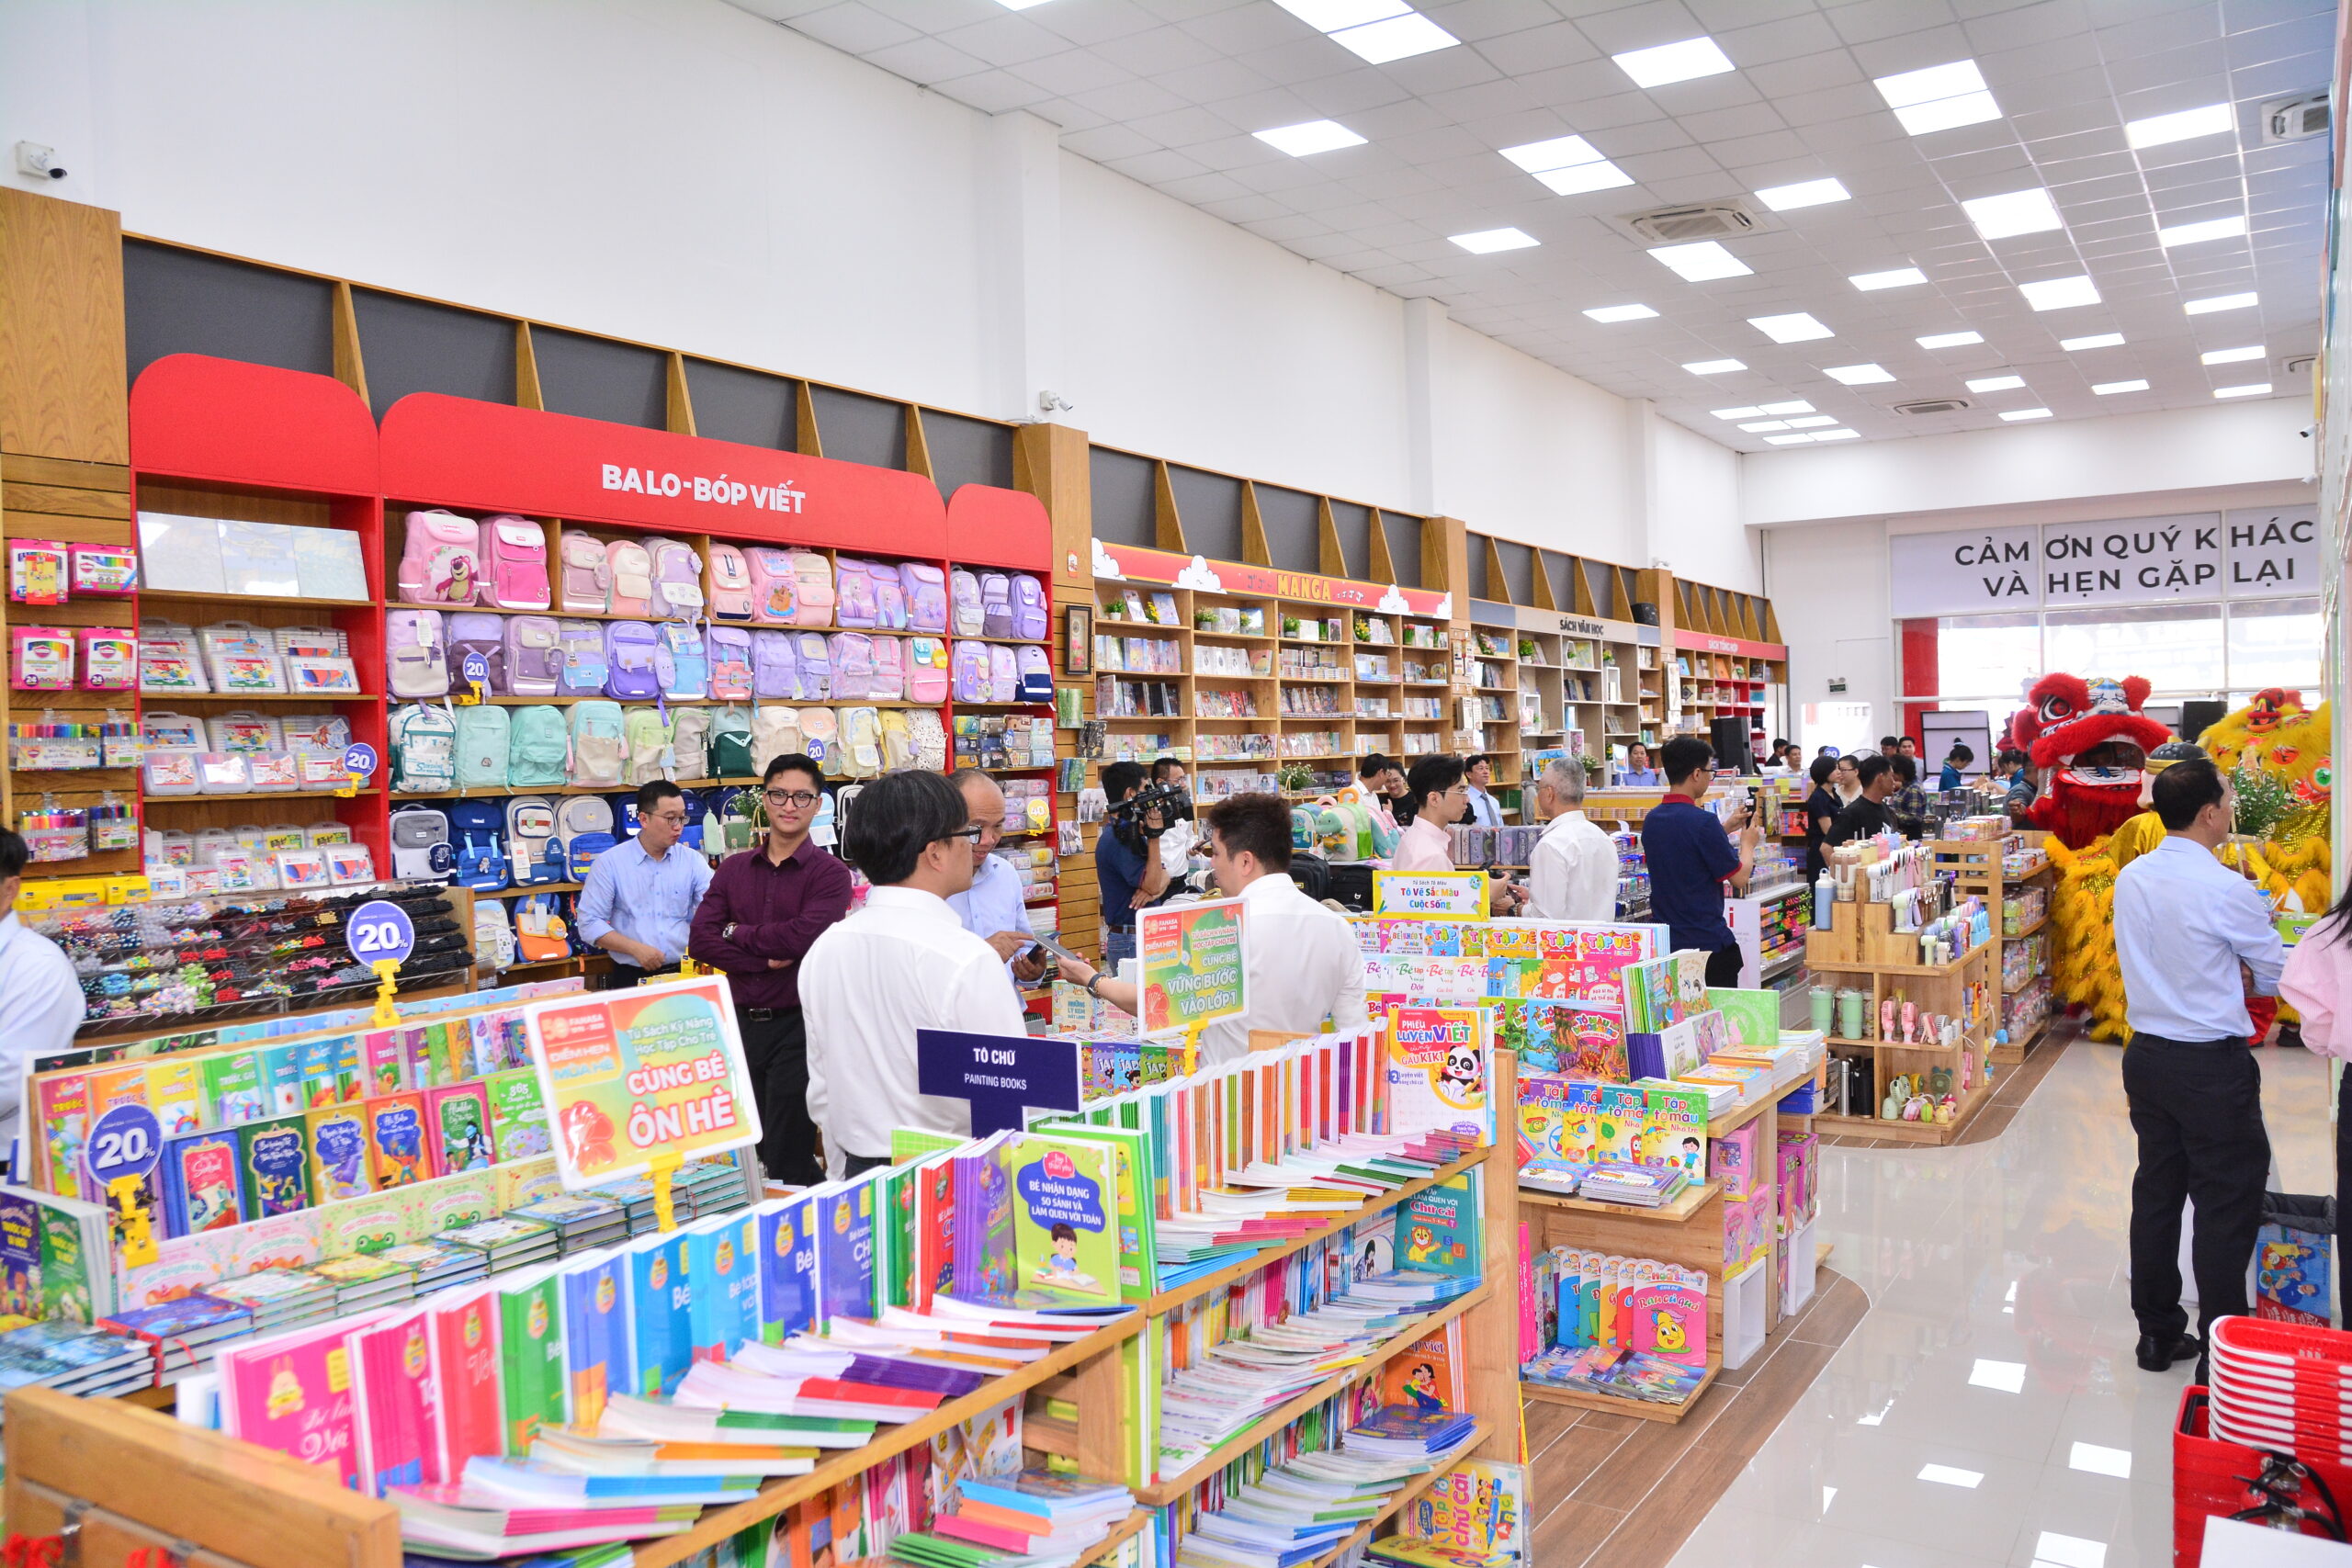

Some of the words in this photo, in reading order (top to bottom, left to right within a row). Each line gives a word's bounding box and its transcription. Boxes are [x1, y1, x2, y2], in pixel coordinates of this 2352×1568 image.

[602, 463, 748, 506] BALO-BÓP
[750, 479, 806, 514] VIẾT
[1954, 536, 2030, 567] CẢM
[2044, 534, 2093, 560] ƠN
[2102, 525, 2182, 560] QUÝ
[1983, 570, 2030, 598] VÀ
[2048, 568, 2121, 599] HẸN
[2138, 559, 2216, 592] GẶP
[2232, 557, 2295, 588] LẠI
[1276, 573, 1331, 601] MANGA
[1559, 618, 1578, 633] SÁCH
[1578, 620, 1593, 635] VĂN
[1591, 623, 1604, 637] HỌC
[1707, 637, 1719, 650] SÁCH
[1400, 887, 1411, 897] Tô
[1413, 887, 1424, 897] Vẽ
[1425, 886, 1440, 897] Sắc
[1441, 888, 1459, 897] Màu
[1409, 899, 1430, 910] Cuộc
[1430, 898, 1452, 910] Sống
[1159, 919, 1178, 927] FAHASA
[1433, 927, 1457, 943] TẬP
[1493, 931, 1518, 946] TẬP
[1520, 930, 1537, 943] VẼ
[1547, 931, 1573, 948] TẬP
[1587, 933, 1612, 950] TẬP
[1613, 933, 1632, 949] VẼ
[1202, 953, 1224, 966] CÙNG
[1225, 950, 1238, 963] BÉ
[1397, 963, 1413, 976] Bé
[1429, 964, 1443, 976] Bé
[1460, 964, 1475, 977] Bé
[1167, 973, 1203, 995] VỮNG
[1203, 968, 1238, 988] BƯỚC
[1180, 994, 1206, 1017] VÀO
[1206, 991, 1230, 1010] LỚP
[569, 1013, 604, 1025] FAHASA
[643, 1023, 670, 1038] Sách
[684, 1017, 713, 1032] Năng
[1402, 1019, 1426, 1030] PHIẾU
[1396, 1029, 1432, 1044] LUYỆN
[1431, 1021, 1471, 1043] VIẾT
[634, 1043, 655, 1055] Học
[656, 1038, 678, 1054] Tập
[678, 1034, 699, 1047] Cho
[972, 1047, 989, 1063] TÔ
[990, 1049, 1016, 1066] CHỮ
[1401, 1052, 1419, 1066] GẤU
[1419, 1050, 1445, 1063] KIKI
[628, 1063, 693, 1095] CÙNG
[694, 1050, 727, 1082] BÉ
[965, 1073, 999, 1087] PAINTING
[1001, 1077, 1027, 1090] BOOKS
[1574, 1102, 1589, 1114] tô
[1617, 1092, 1642, 1107] Tập
[1662, 1096, 1688, 1111] Tập
[628, 1103, 684, 1148] ÔN
[686, 1087, 735, 1134] HÈ
[1608, 1105, 1622, 1117] tô
[1623, 1106, 1643, 1119] mà
[1654, 1109, 1668, 1122] tô
[1668, 1110, 1699, 1124] màu
[1029, 1179, 1040, 1192] BÉ
[1042, 1179, 1065, 1196] NHẬN
[1066, 1186, 1090, 1201] DẠNG
[1041, 1197, 1052, 1207] SO
[1052, 1196, 1072, 1209] SÁNH
[1072, 1199, 1083, 1212] VÀ
[1413, 1193, 1428, 1202] LÀM
[1428, 1194, 1446, 1204] QUEN
[1446, 1197, 1459, 1206] VỚI
[1032, 1205, 1047, 1218] LÀM
[1048, 1209, 1069, 1221] QUEN
[1069, 1210, 1081, 1223] VỚI
[1081, 1211, 1102, 1225] TOÁN
[1409, 1201, 1437, 1215] Chữ
[1437, 1205, 1456, 1218] cái
[796, 1246, 814, 1273] Bé
[1638, 1295, 1662, 1308] Rau
[1662, 1292, 1677, 1304] củ
[1424, 1339, 1445, 1355] viết
[1432, 1475, 1450, 1498] tô
[1449, 1472, 1470, 1506] cái
[1434, 1499, 1450, 1535] Tập
[1451, 1506, 1471, 1547] chữ
